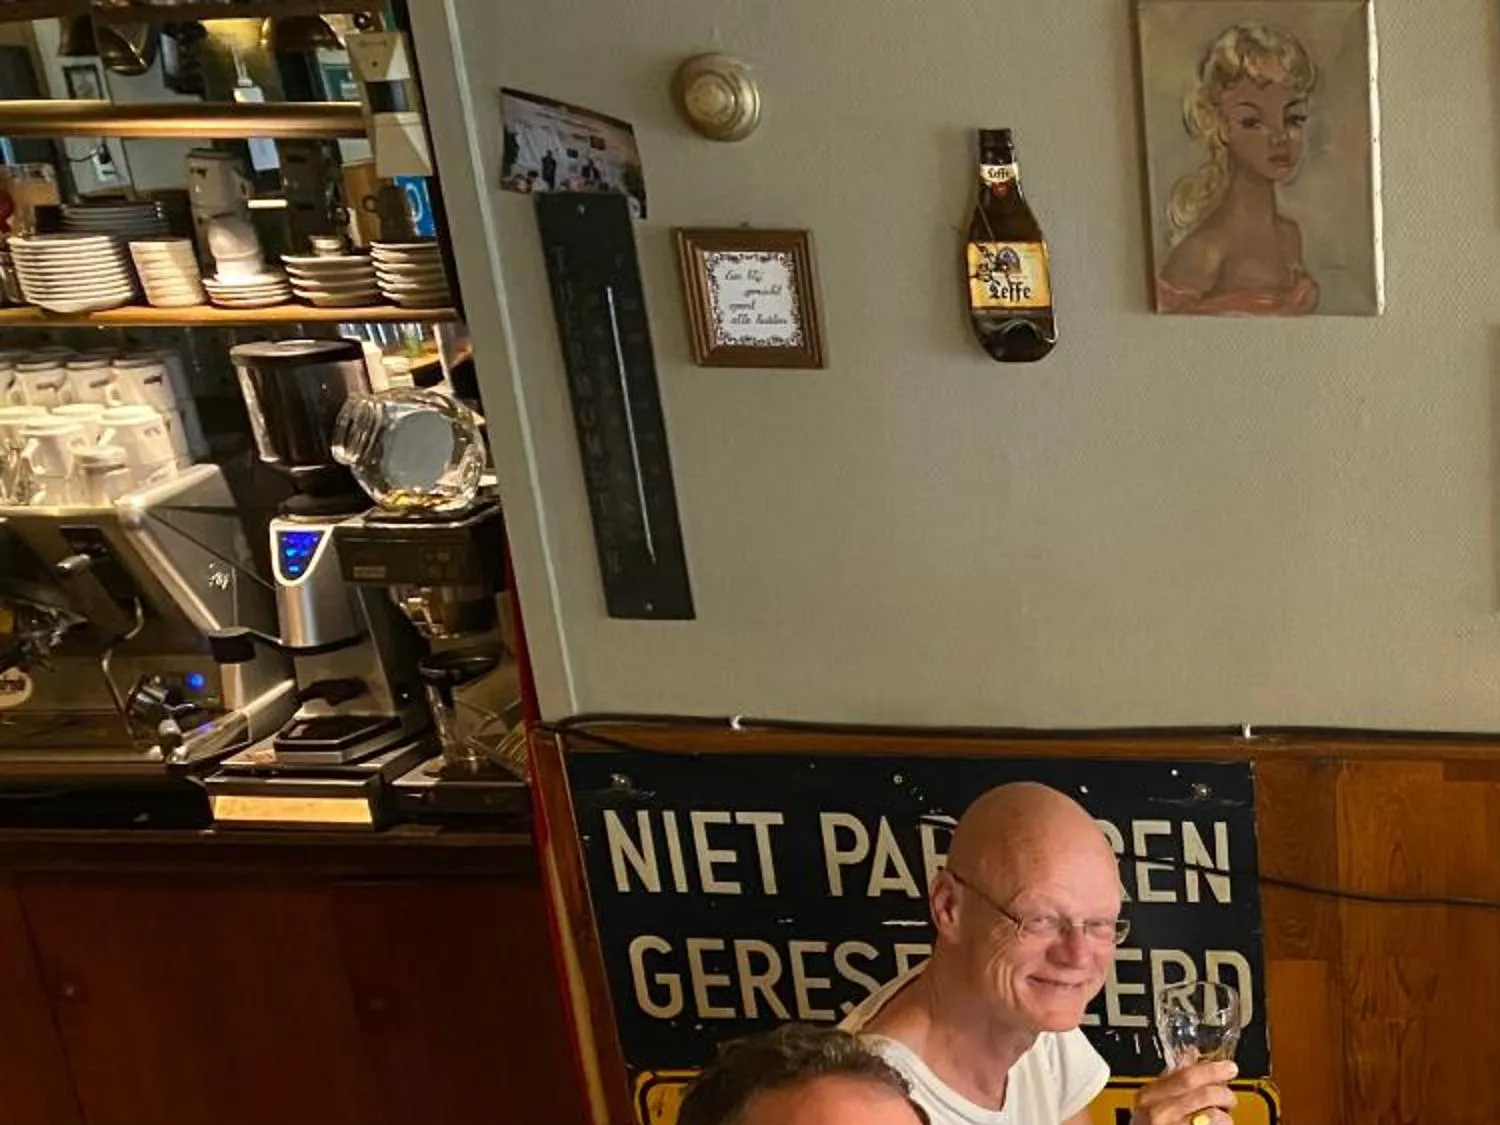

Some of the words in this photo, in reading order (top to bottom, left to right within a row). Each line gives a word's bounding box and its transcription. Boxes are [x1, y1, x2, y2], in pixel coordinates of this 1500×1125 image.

[989, 281, 1032, 303] Leffe
[603, 810, 785, 895] NIET
[819, 811, 1232, 904] PAEN
[628, 935, 1253, 1028] GERESERD
